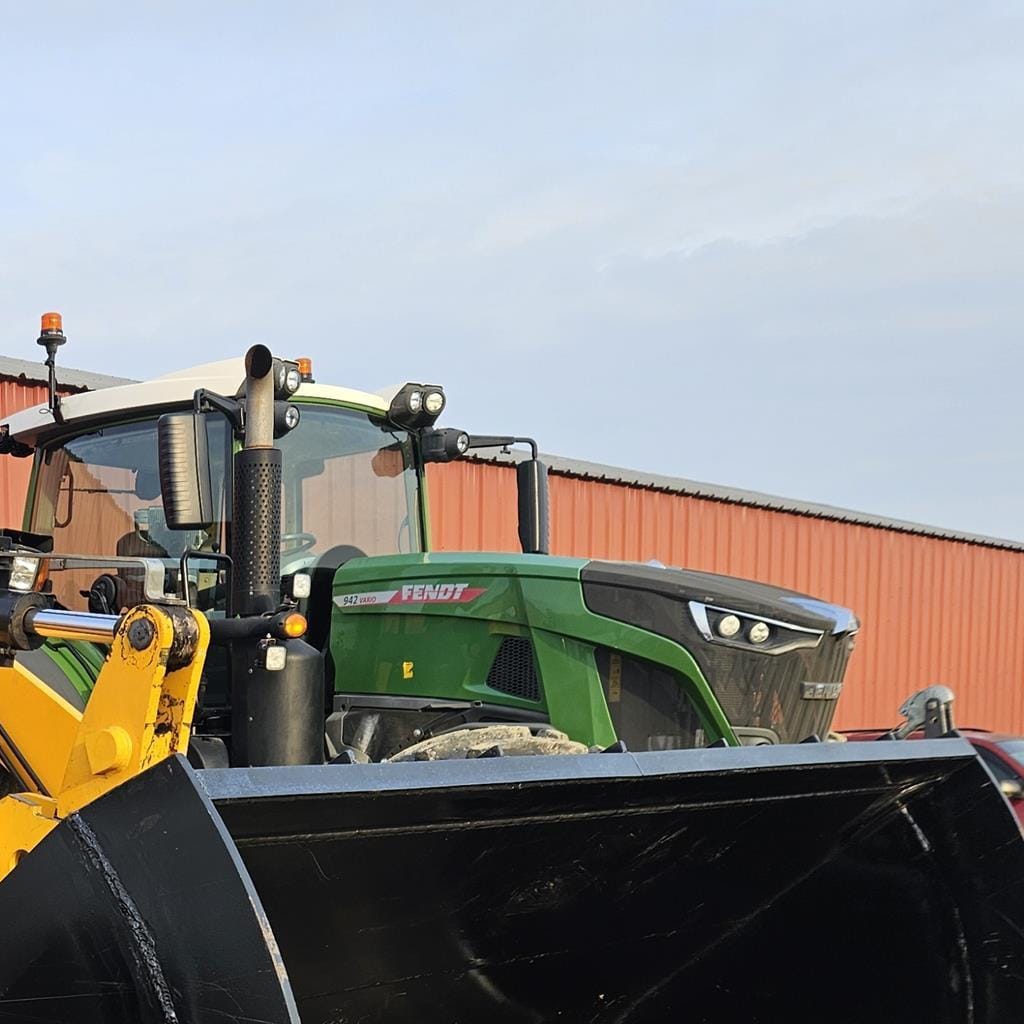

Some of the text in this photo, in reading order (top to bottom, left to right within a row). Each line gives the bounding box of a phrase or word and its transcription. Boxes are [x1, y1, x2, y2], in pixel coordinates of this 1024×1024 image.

[401, 583, 469, 601] FENDT
[343, 595, 377, 606] 942 VARIO
